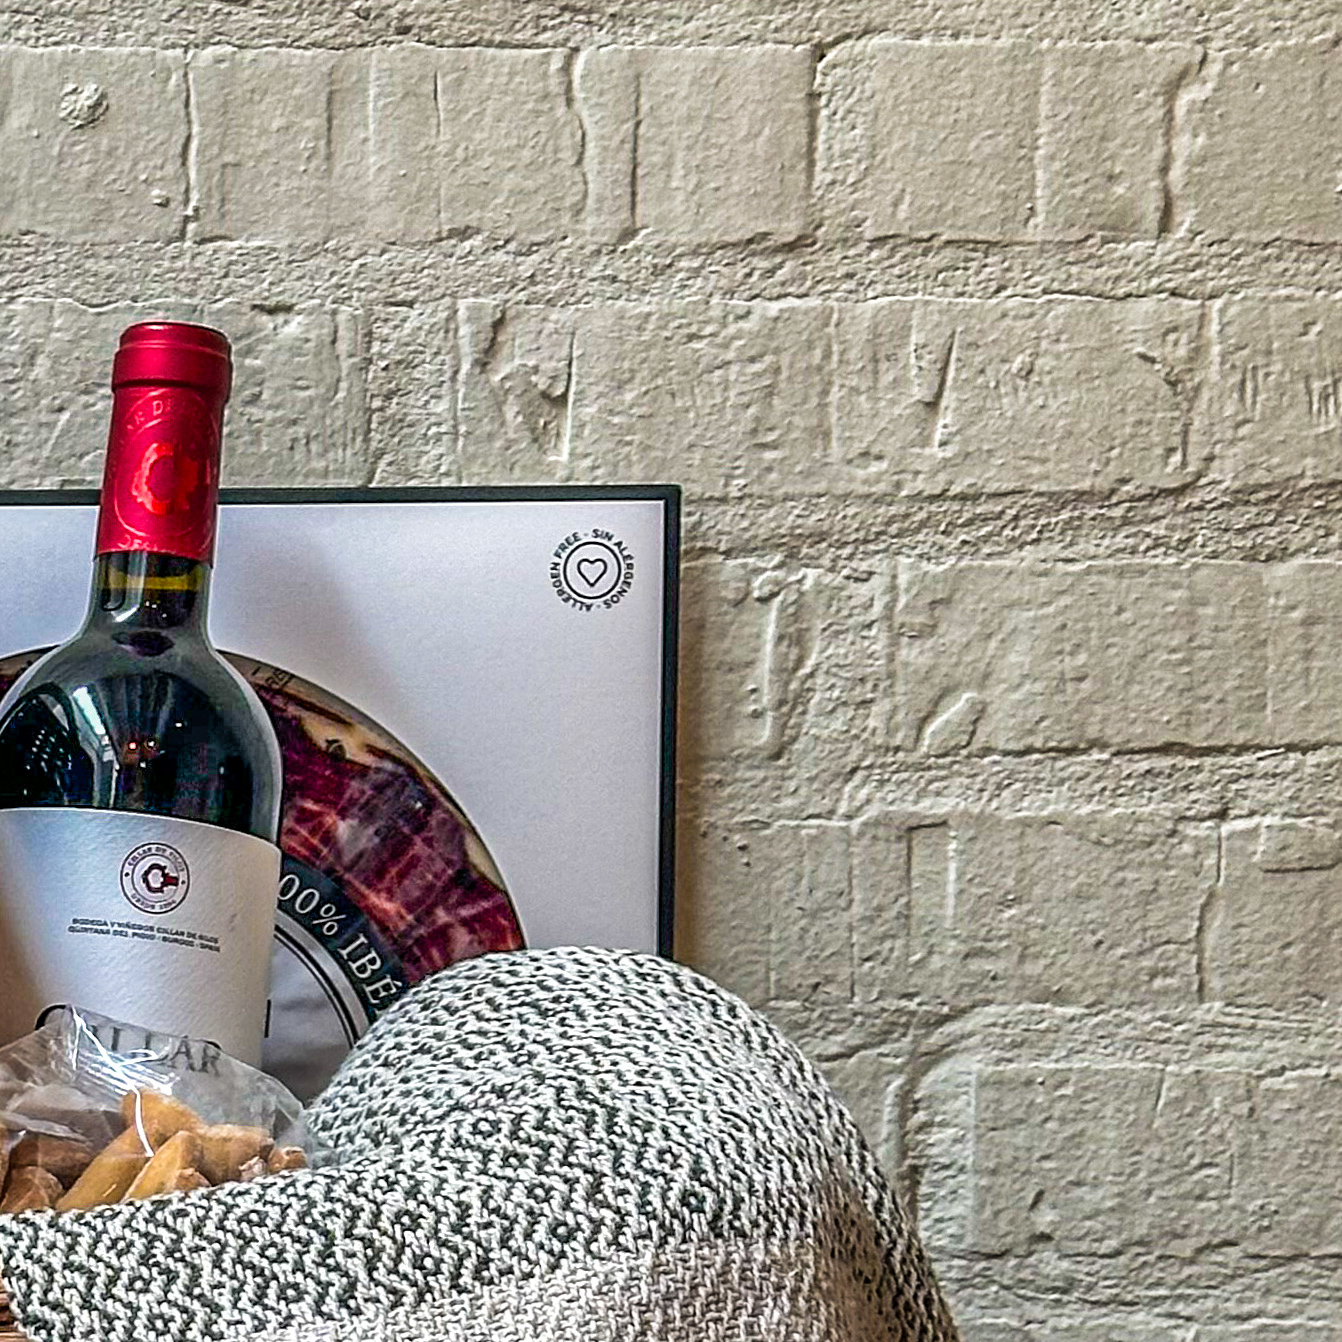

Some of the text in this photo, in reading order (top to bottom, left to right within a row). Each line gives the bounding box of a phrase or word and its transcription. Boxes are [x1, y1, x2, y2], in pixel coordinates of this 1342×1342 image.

[553, 532, 582, 560] FREE
[592, 528, 614, 541] SIN
[278, 875, 346, 935] 00%
[337, 932, 403, 1005] IBÉ
